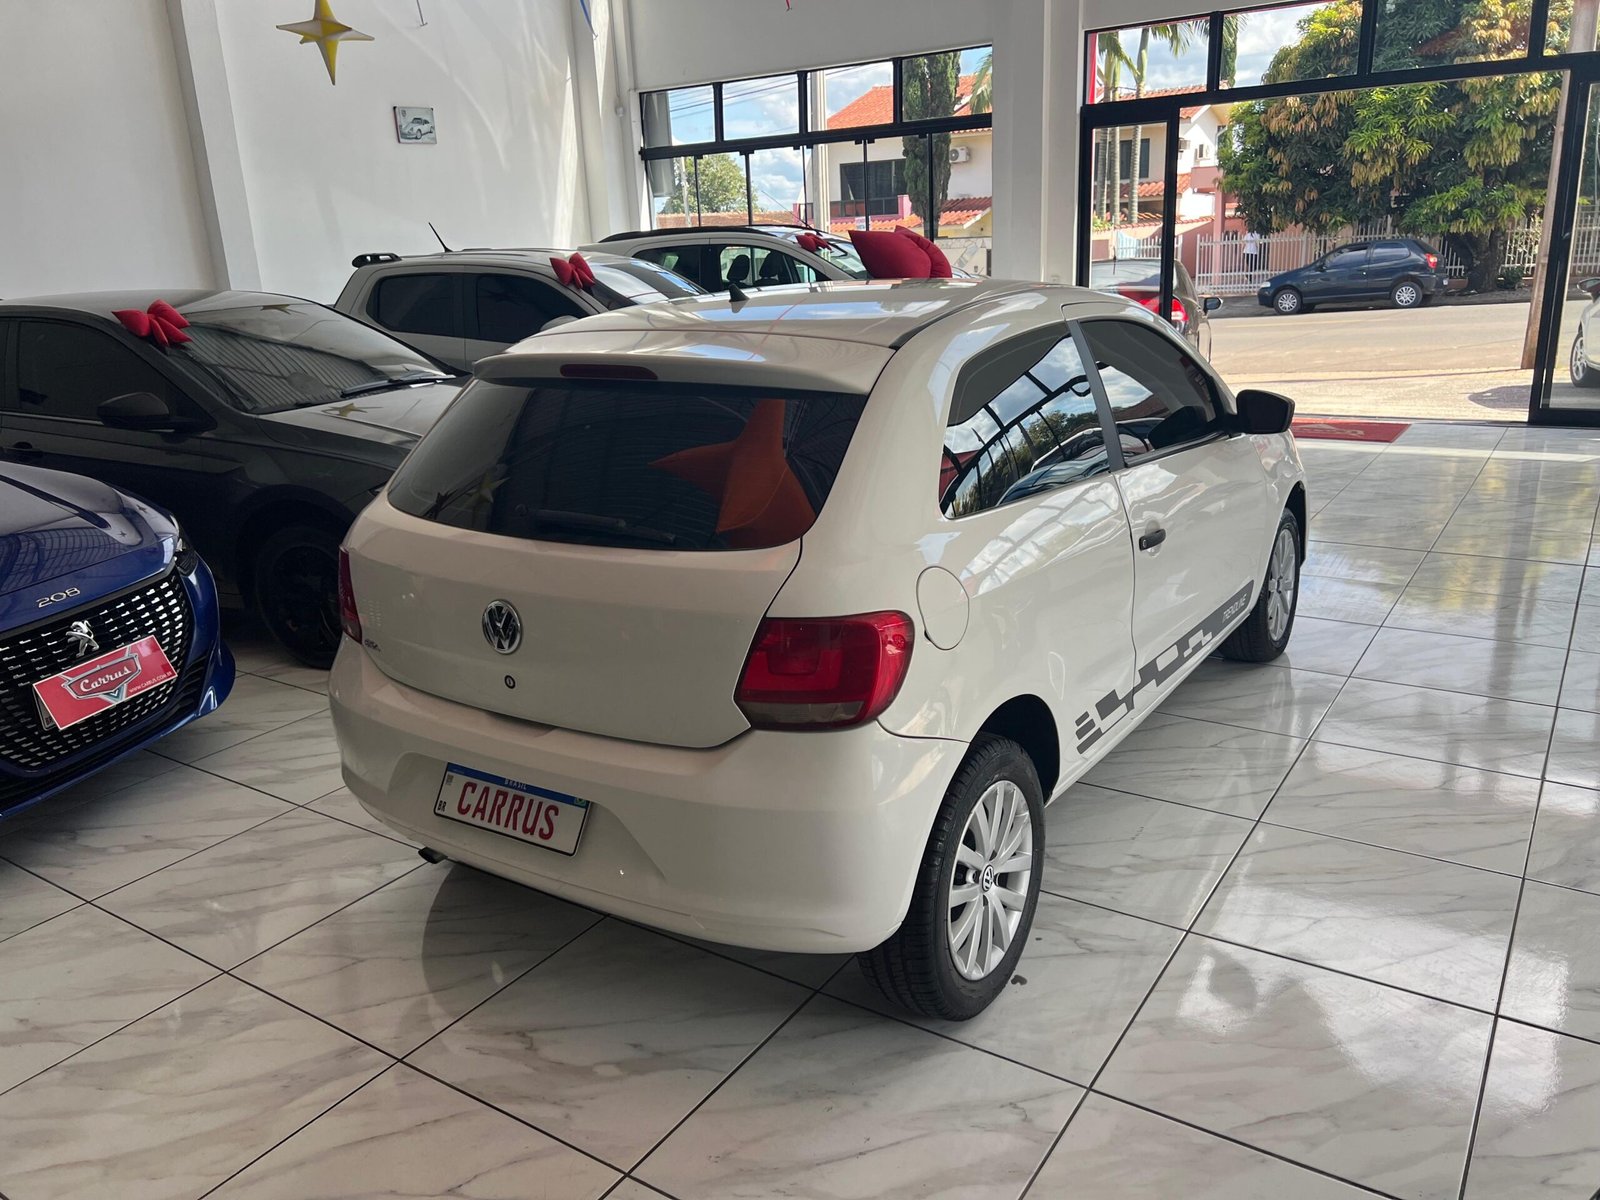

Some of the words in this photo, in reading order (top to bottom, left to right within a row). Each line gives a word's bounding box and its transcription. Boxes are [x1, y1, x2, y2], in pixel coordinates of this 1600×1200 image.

[36, 587, 81, 609] 208
[80, 666, 131, 692] Carrus
[503, 777, 528, 791] BRASIL
[437, 800, 447, 812] BR
[457, 781, 560, 841] CARRUS
